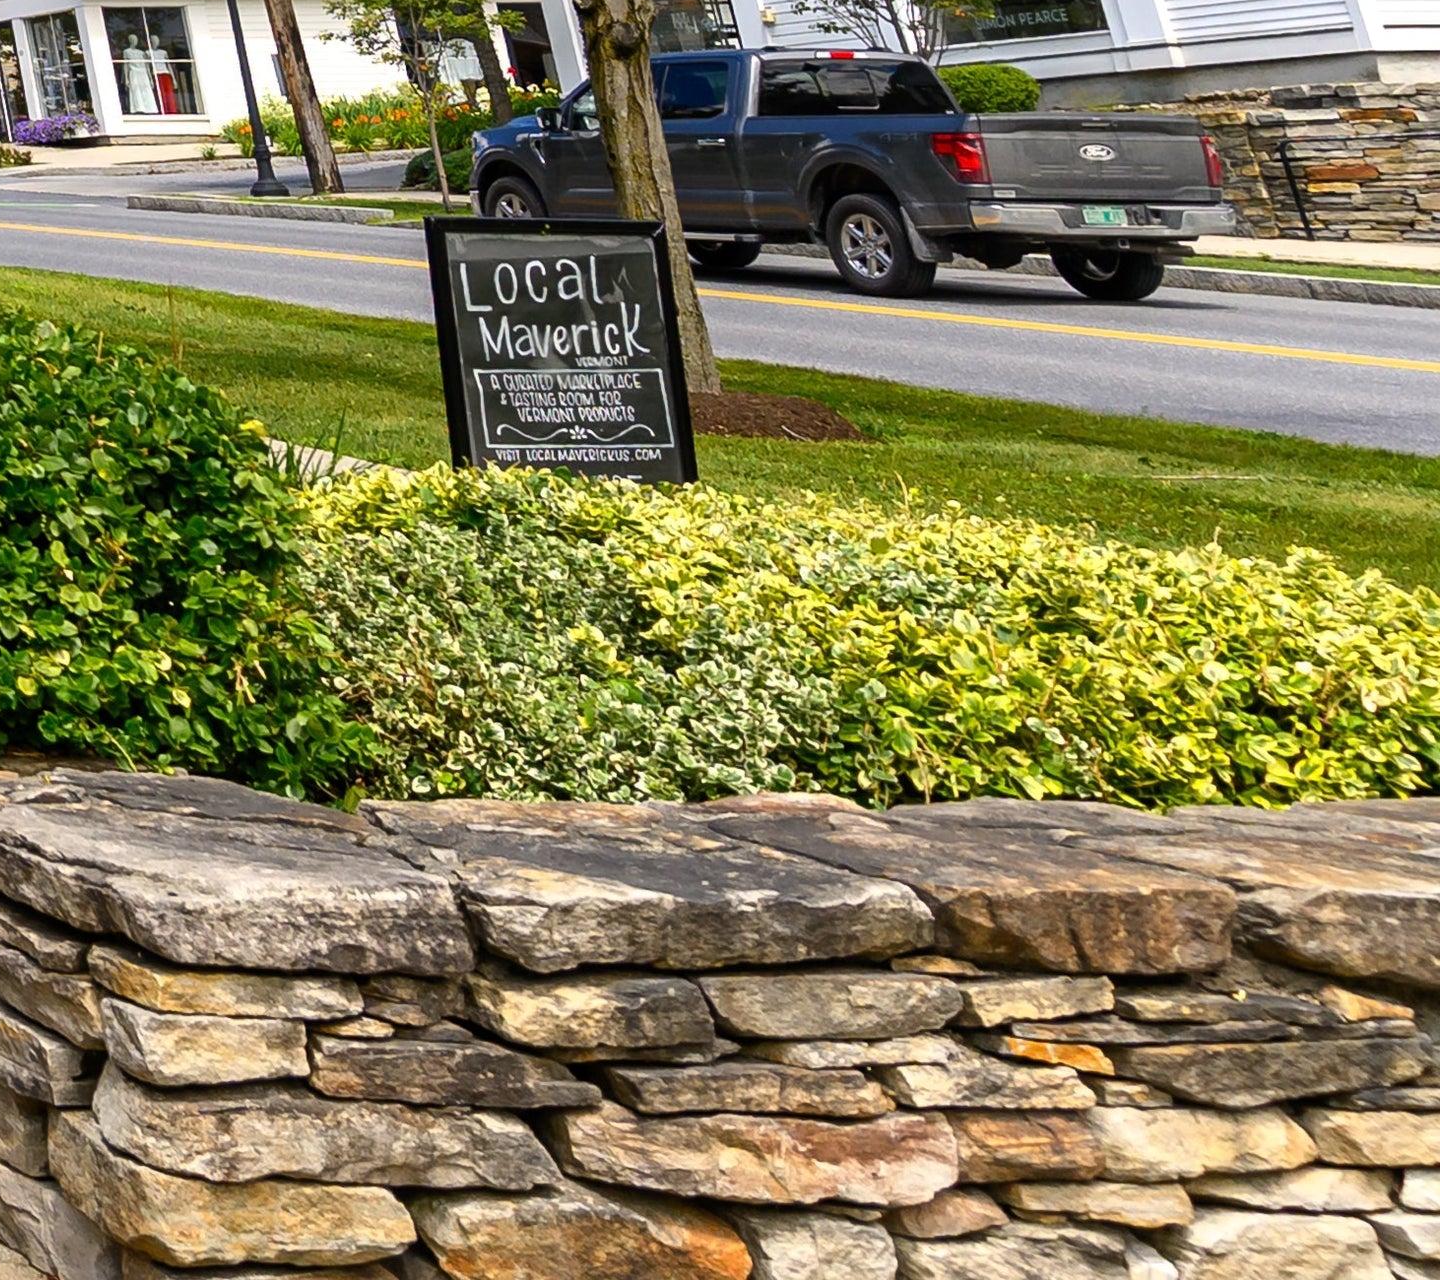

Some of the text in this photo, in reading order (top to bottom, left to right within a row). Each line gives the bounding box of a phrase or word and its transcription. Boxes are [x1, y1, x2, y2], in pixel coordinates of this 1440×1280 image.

[975, 8, 1069, 30] SIMON PEARCE
[575, 355, 629, 368] VERMONT
[490, 373, 642, 391] A CURATED MARKETPLACE
[509, 392, 556, 407] TASTING
[558, 391, 595, 407] ROOM
[599, 390, 622, 406] FOR
[516, 405, 636, 423] VERMONT PRODUCTS
[495, 449, 521, 462] VISIT
